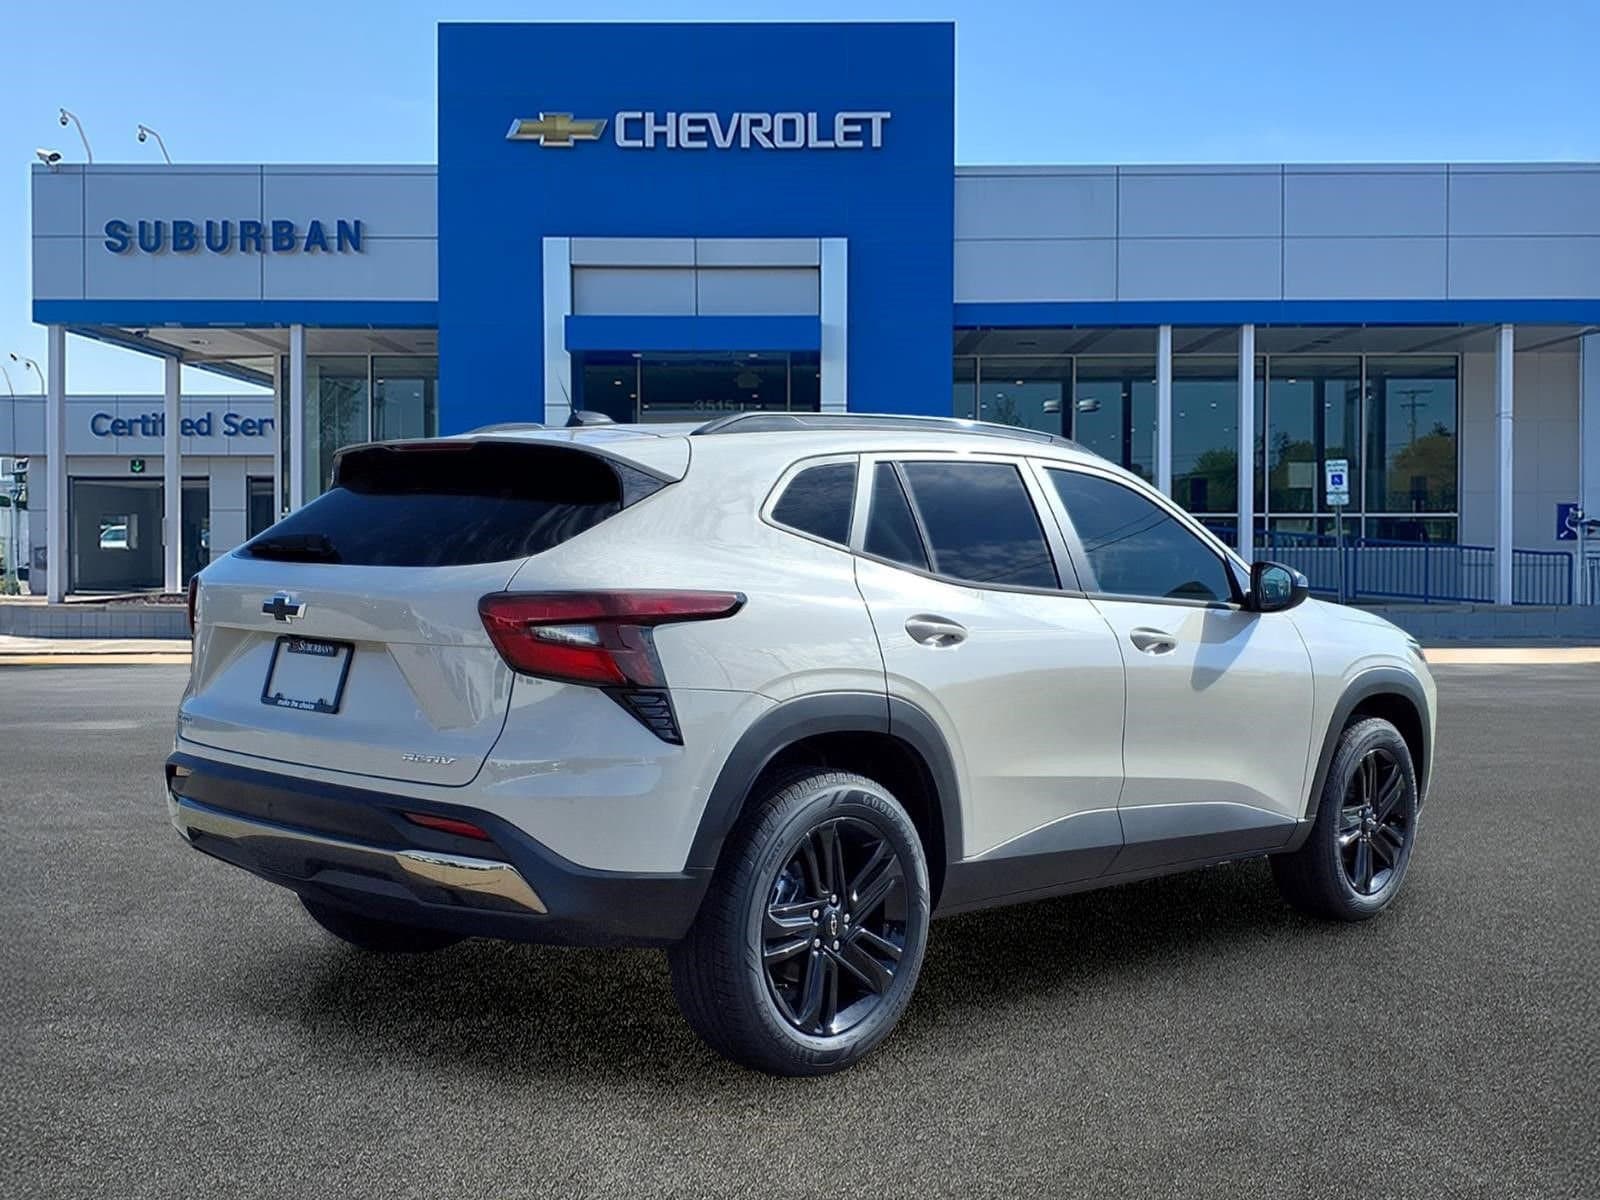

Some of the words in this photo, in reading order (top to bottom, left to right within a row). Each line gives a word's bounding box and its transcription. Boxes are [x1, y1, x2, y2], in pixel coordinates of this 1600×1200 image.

[615, 111, 891, 149] CHEVROLET
[104, 219, 363, 253] SUBURBAN
[90, 412, 212, 437] Certifed
[223, 413, 275, 436] Ser
